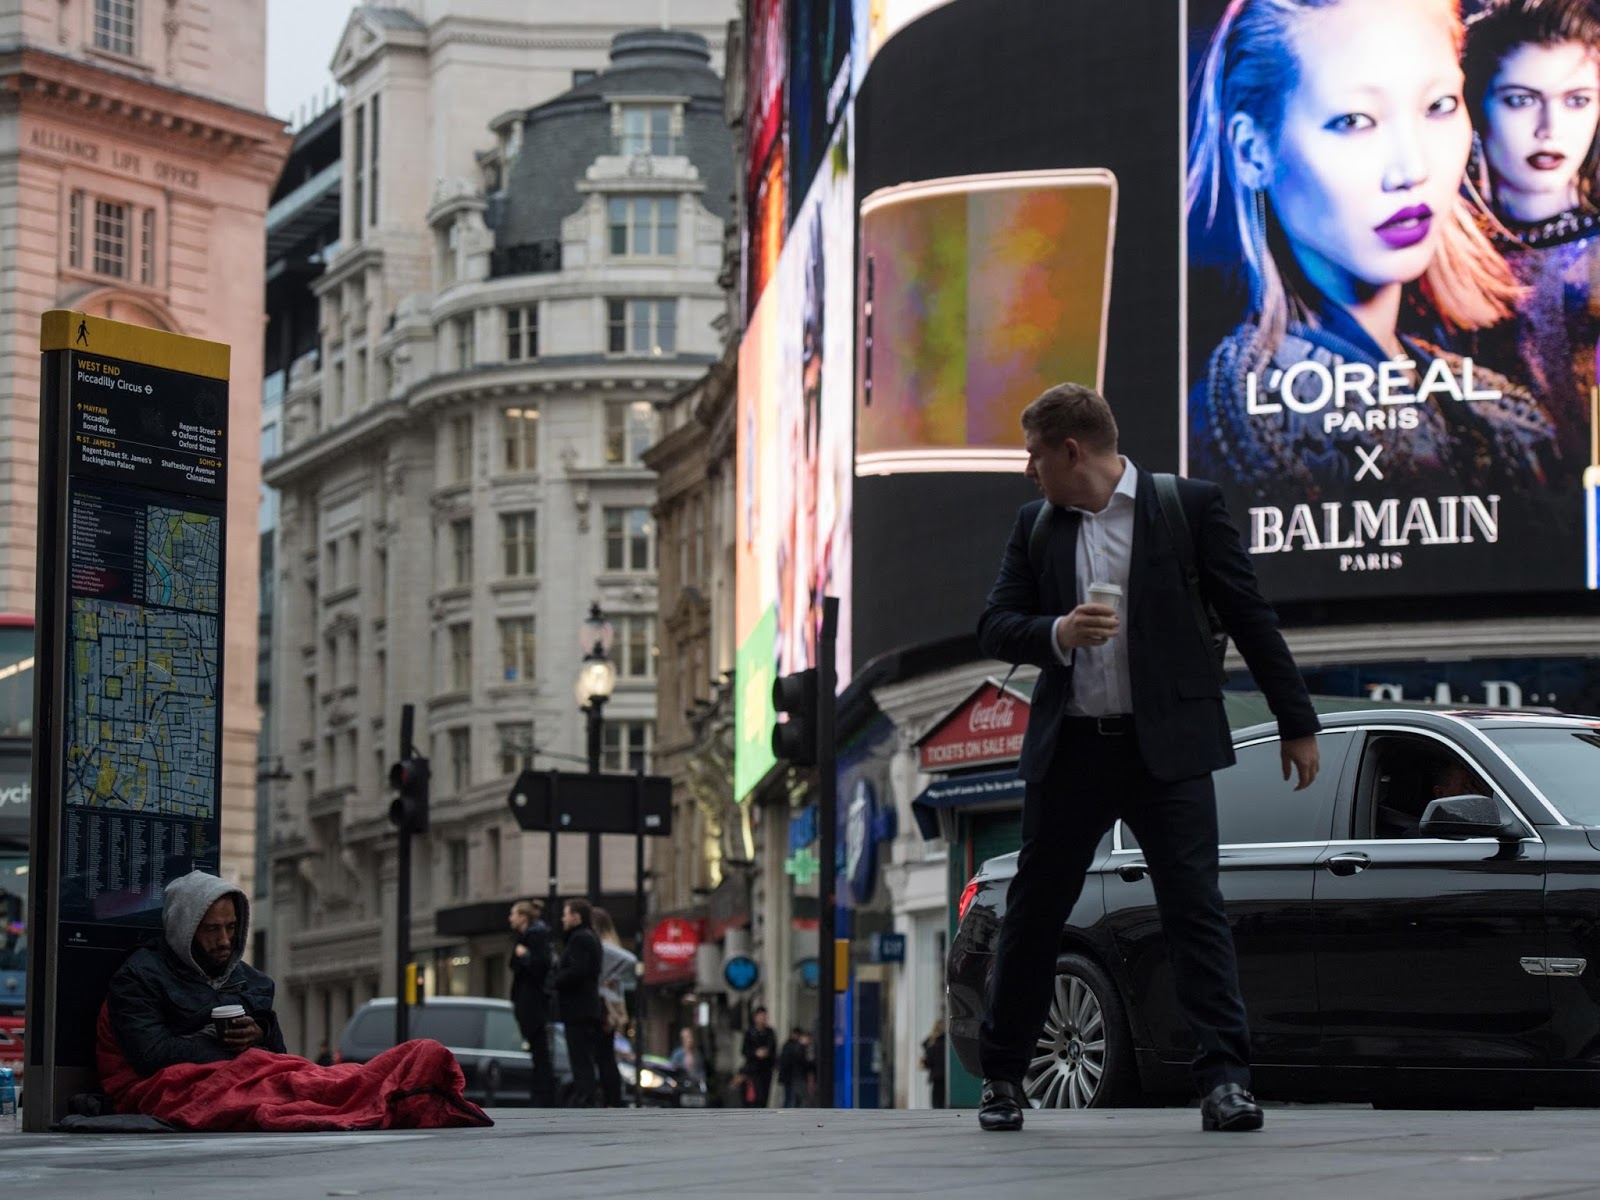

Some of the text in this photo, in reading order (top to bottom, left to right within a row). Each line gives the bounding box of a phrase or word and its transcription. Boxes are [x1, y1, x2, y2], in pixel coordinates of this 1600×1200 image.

[31, 128, 199, 189] ALLIANCE LIFE OFFICE
[77, 358, 121, 376] WEST END
[77, 371, 143, 393] Piccadilly Circus
[83, 404, 108, 415] MAYFAIR
[82, 412, 110, 425] Piccadilly
[82, 422, 117, 434] Bond Street
[179, 422, 216, 436] Regent Street
[92, 439, 116, 449] JAMES'S
[178, 431, 216, 445] Oxford Circus
[178, 440, 216, 453] Oxford Street
[82, 445, 102, 456] Regent
[103, 449, 121, 459] Street
[130, 454, 152, 464] James's
[82, 454, 135, 470] Buckingham Palace
[161, 459, 216, 475] Shaftesbury Avenue
[199, 458, 216, 467] SOHO
[186, 473, 216, 484] Chinatown
[1248, 495, 1500, 555] BALMAIN
[1340, 552, 1402, 573] PARIS
[927, 742, 964, 762] TICKETS
[965, 740, 981, 758] ON
[982, 737, 1005, 755] SALE
